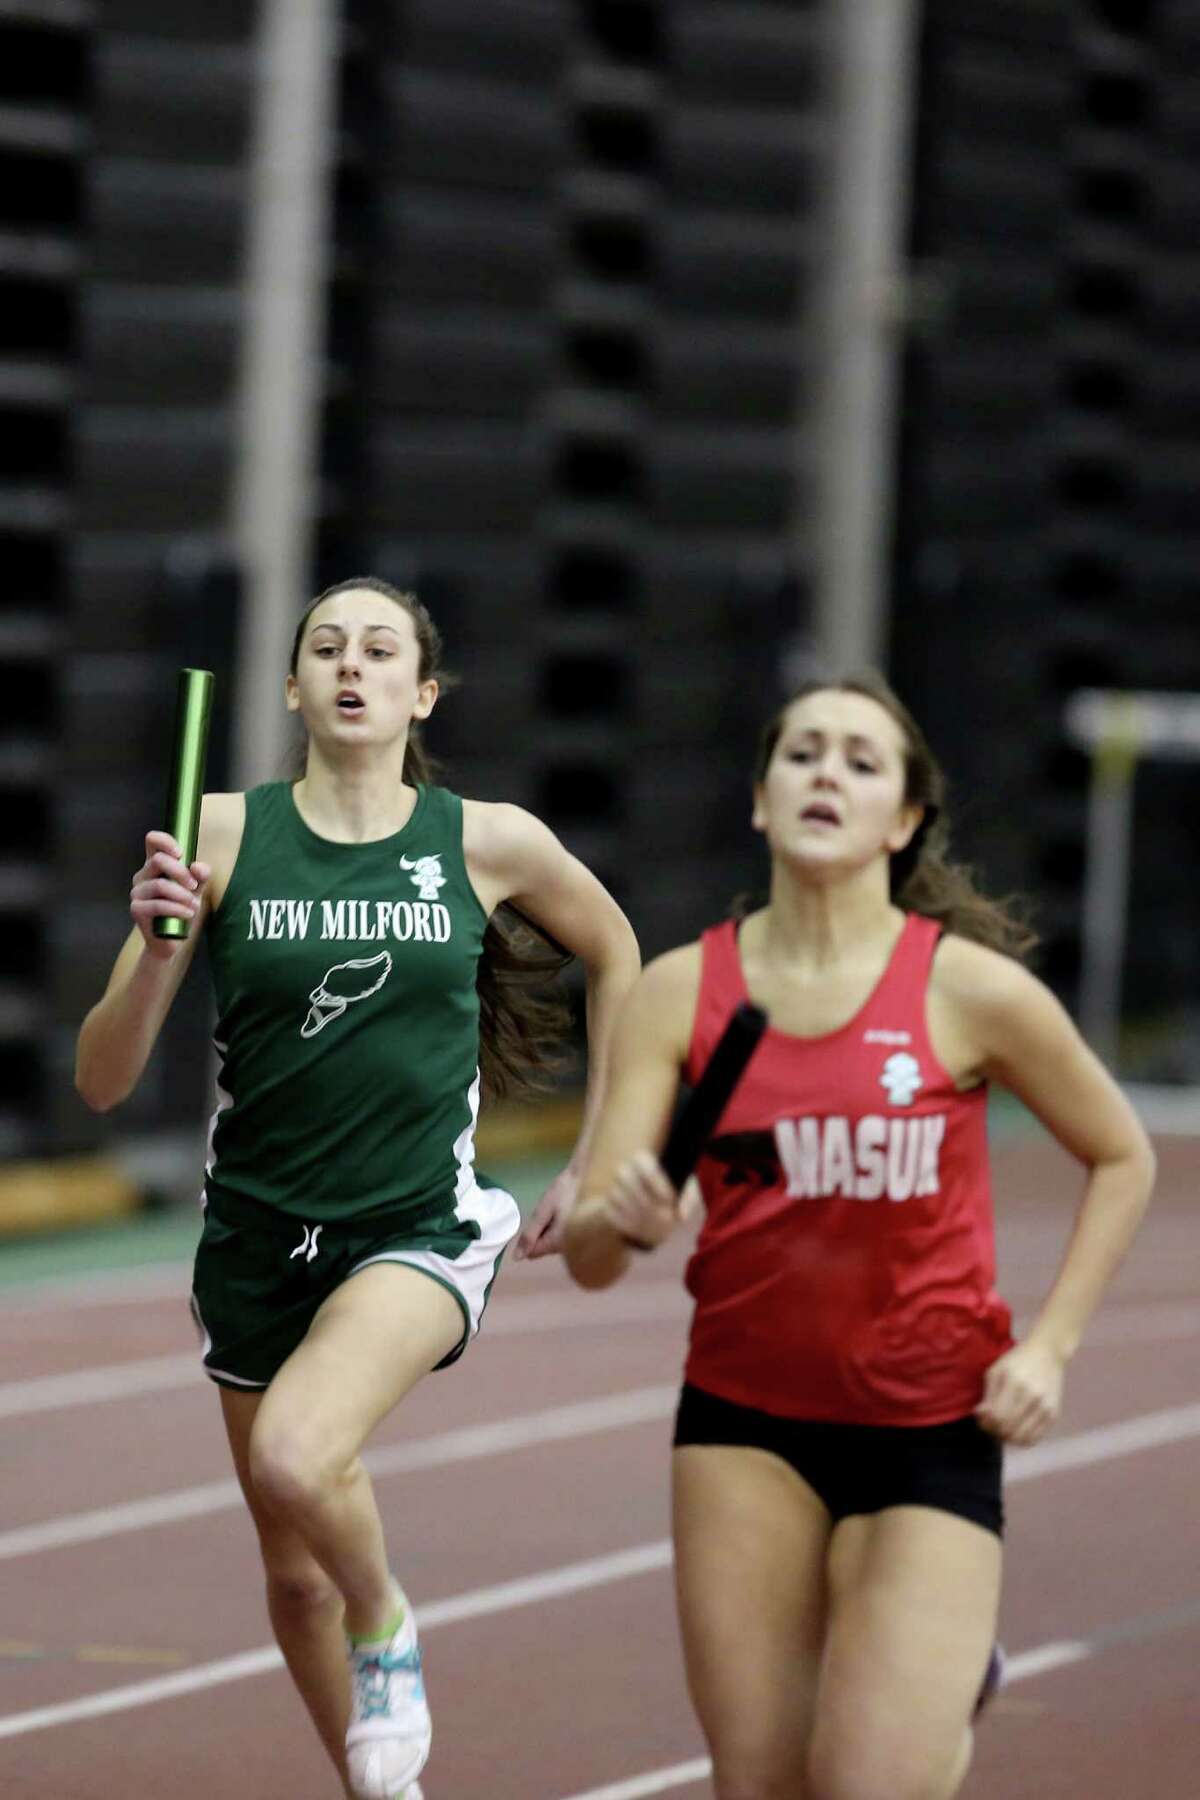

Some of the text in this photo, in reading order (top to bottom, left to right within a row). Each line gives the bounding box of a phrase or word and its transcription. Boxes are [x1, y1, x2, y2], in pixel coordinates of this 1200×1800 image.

[247, 900, 451, 942] NEW MILFORD
[774, 1114, 946, 1201] MASUK
